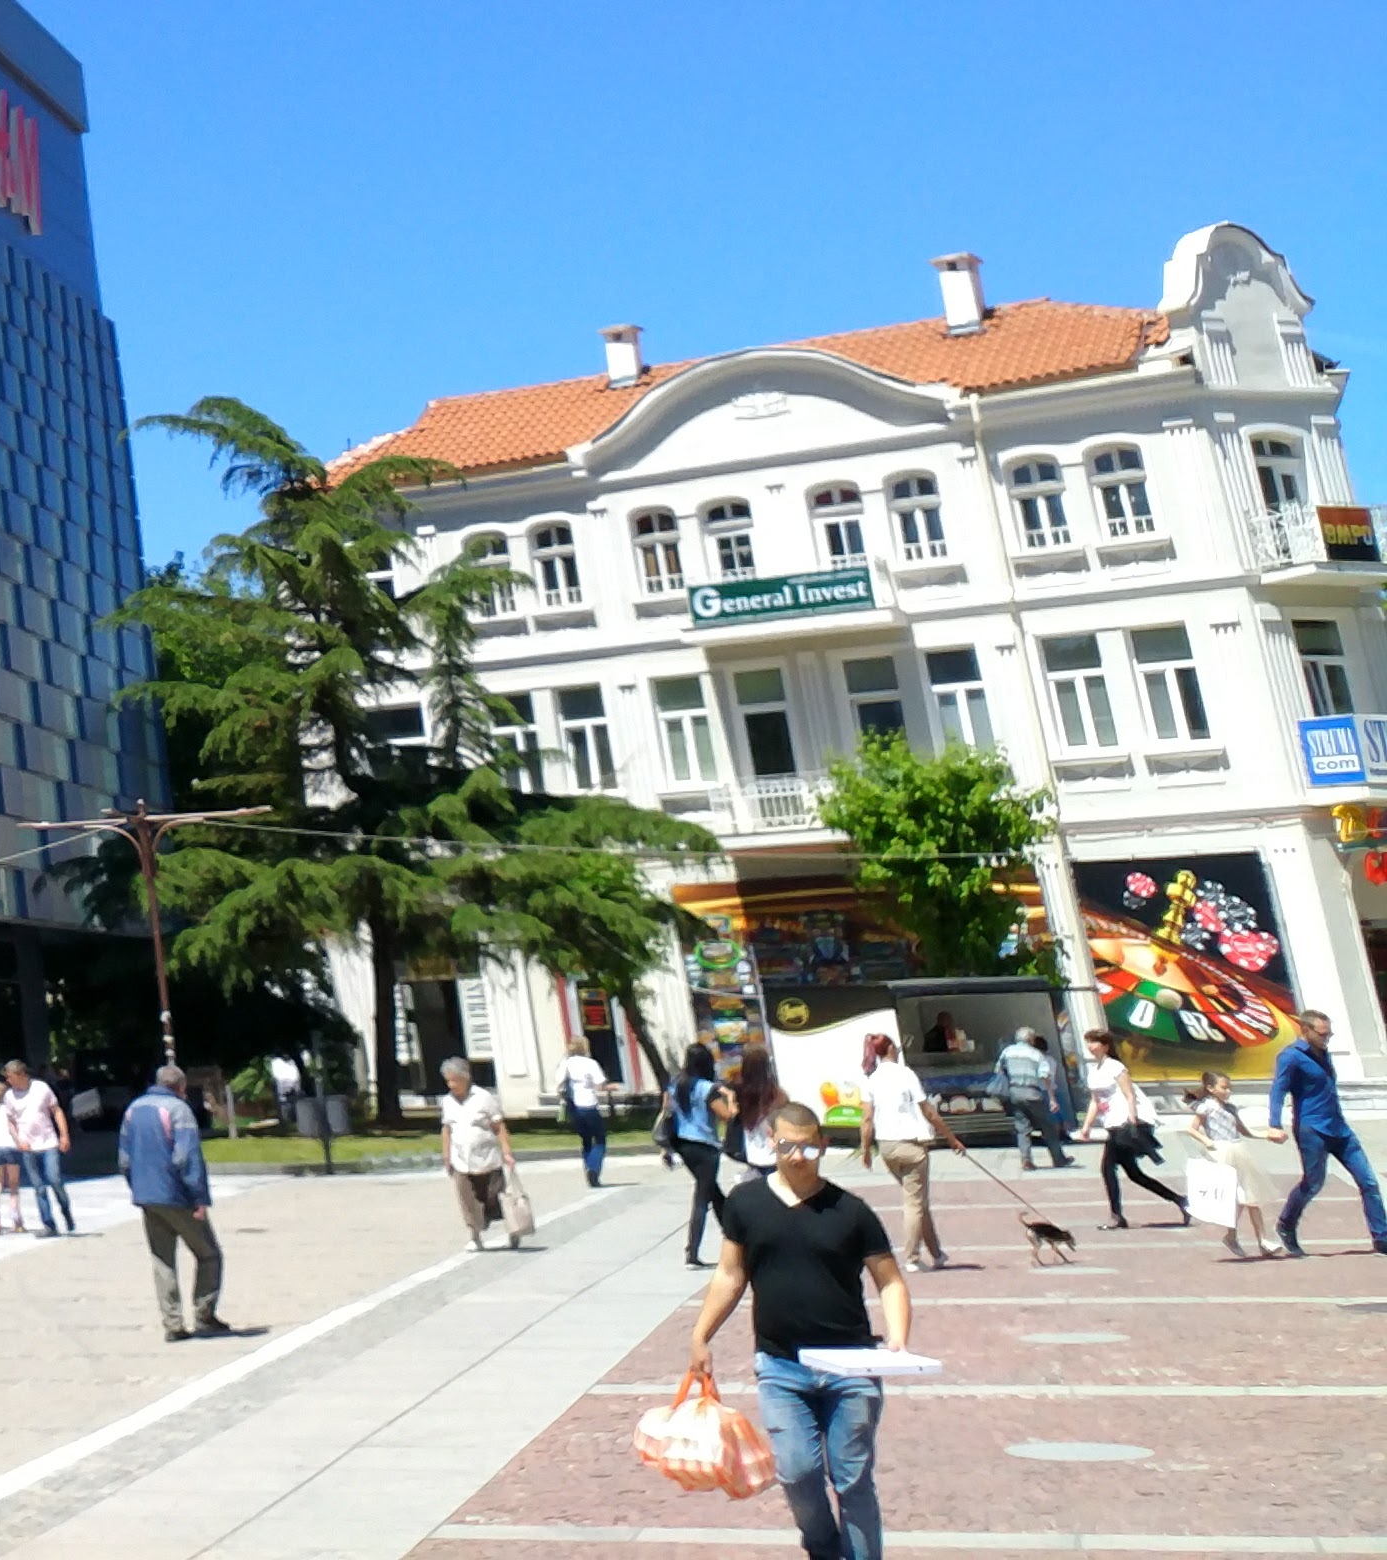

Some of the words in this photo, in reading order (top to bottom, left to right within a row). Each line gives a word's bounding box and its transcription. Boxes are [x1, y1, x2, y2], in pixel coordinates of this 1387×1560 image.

[692, 585, 794, 618] General
[797, 580, 869, 605] Invest
[1306, 726, 1357, 757] STRUMA
[1315, 757, 1356, 771] com
